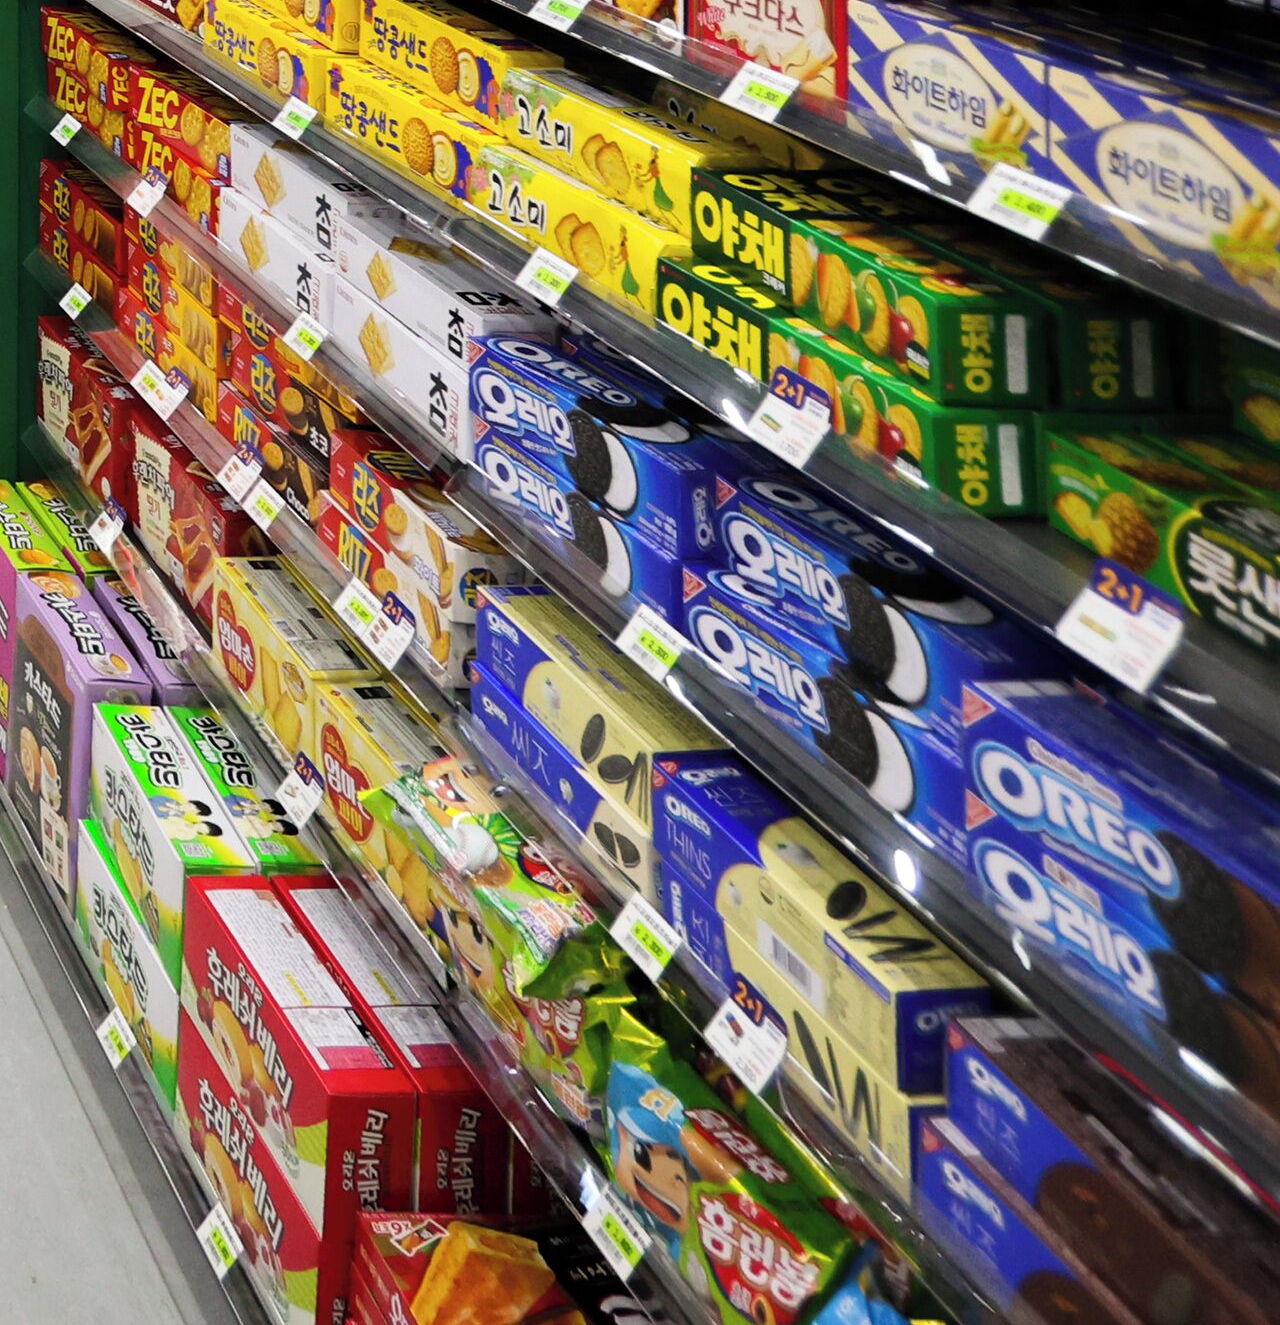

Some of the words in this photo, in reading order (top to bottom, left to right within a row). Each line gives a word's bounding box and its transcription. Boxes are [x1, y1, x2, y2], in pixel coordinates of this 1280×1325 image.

[46, 16, 76, 63] ZEC
[212, 20, 258, 71] 땅콩샌드
[374, 18, 429, 73] 땅콩샌드
[696, 5, 727, 28] White
[54, 67, 87, 114] ZEC
[137, 75, 180, 129] ZEC
[339, 88, 402, 154] 땅콩샌드
[516, 92, 574, 156] 고소미
[890, 63, 988, 130] 화이트하임
[486, 167, 549, 236] 고소미
[1106, 144, 1234, 226] 화이트하임
[694, 188, 786, 283] 야채
[661, 281, 765, 382] 야채
[959, 314, 994, 395] 야채
[488, 337, 637, 409] OREO
[775, 375, 807, 408] 2+1
[480, 371, 577, 456] 오레오
[486, 450, 575, 540] 오레오
[955, 423, 989, 508] 야채
[284, 488, 310, 523] Choco
[727, 514, 851, 631] 오레오
[1096, 566, 1143, 615] 2+1
[39, 591, 106, 657] 카스타드
[23, 661, 63, 730] 카스타드
[692, 606, 830, 734] 오레오
[665, 817, 713, 880] THINS
[978, 746, 1175, 891] OREO
[980, 844, 1165, 1013] 오레오
[204, 945, 295, 1111] 후레쉬베리
